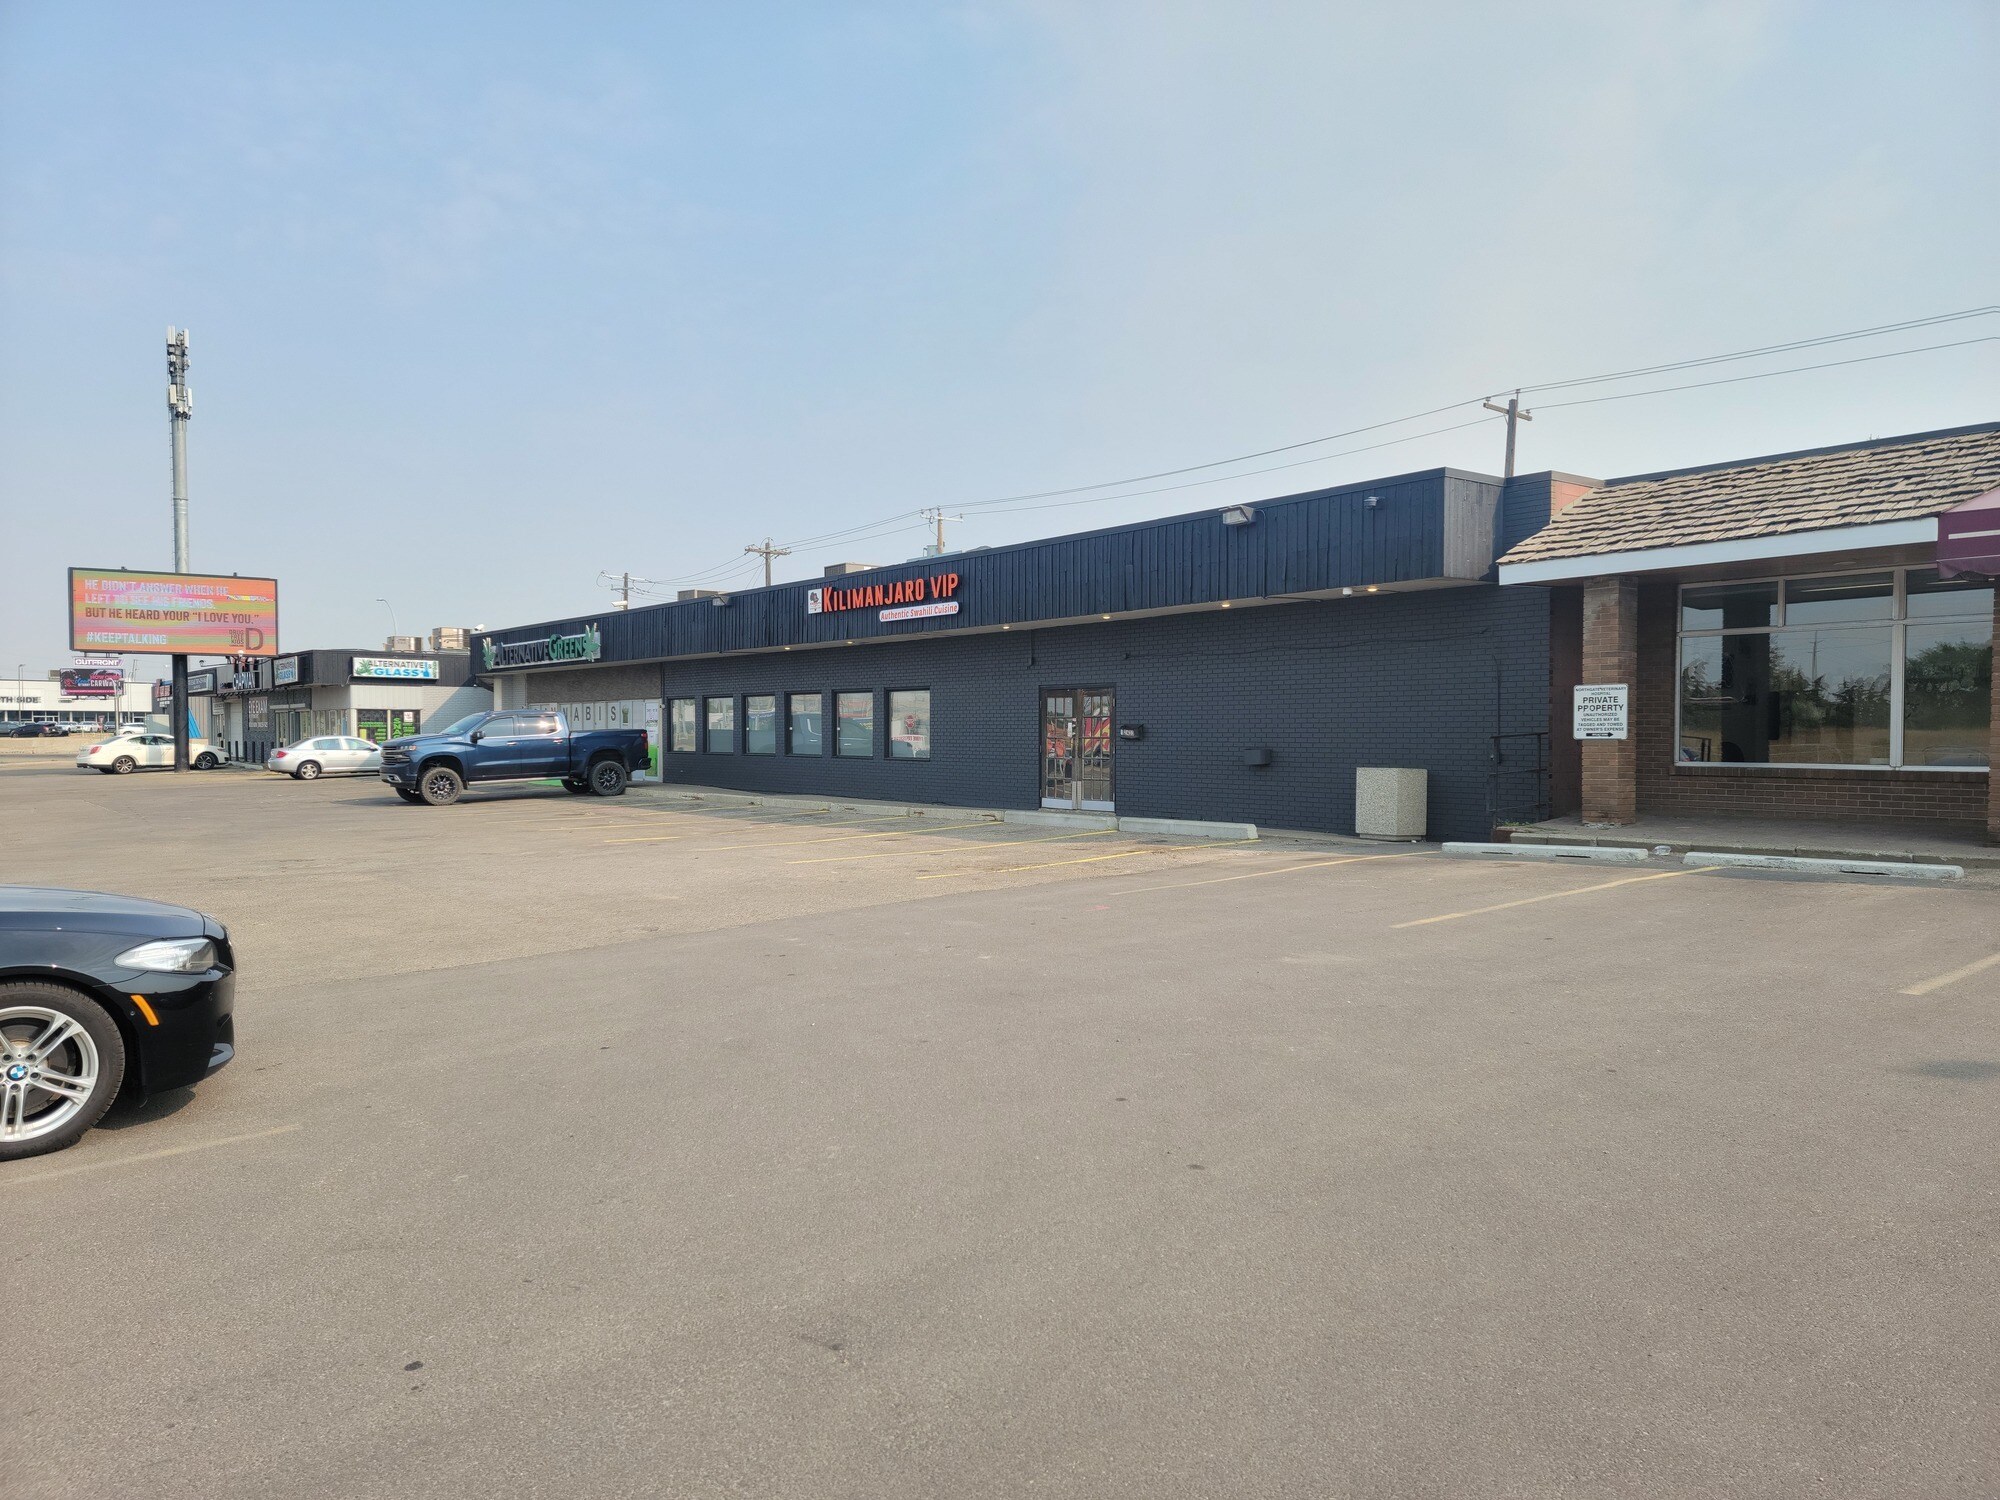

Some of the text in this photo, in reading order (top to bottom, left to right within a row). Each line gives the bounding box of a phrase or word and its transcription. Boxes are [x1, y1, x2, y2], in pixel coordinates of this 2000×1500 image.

[84, 579, 229, 597] HE DIDN'T ANSWER WHEN HE
[930, 573, 959, 598] VIP
[84, 593, 111, 604] LEFT
[85, 607, 107, 618] BUT
[108, 608, 123, 619] HE
[125, 609, 160, 620] HEARD
[163, 610, 190, 621] YOUR
[204, 612, 229, 623] LOVE
[880, 604, 958, 621] Authentic Swahili Cuisine
[86, 631, 168, 645] #KEEPTALKING
[368, 660, 424, 669] ALTERNATIVE
[374, 668, 420, 677] GLASS
[90, 679, 121, 687] CARWA
